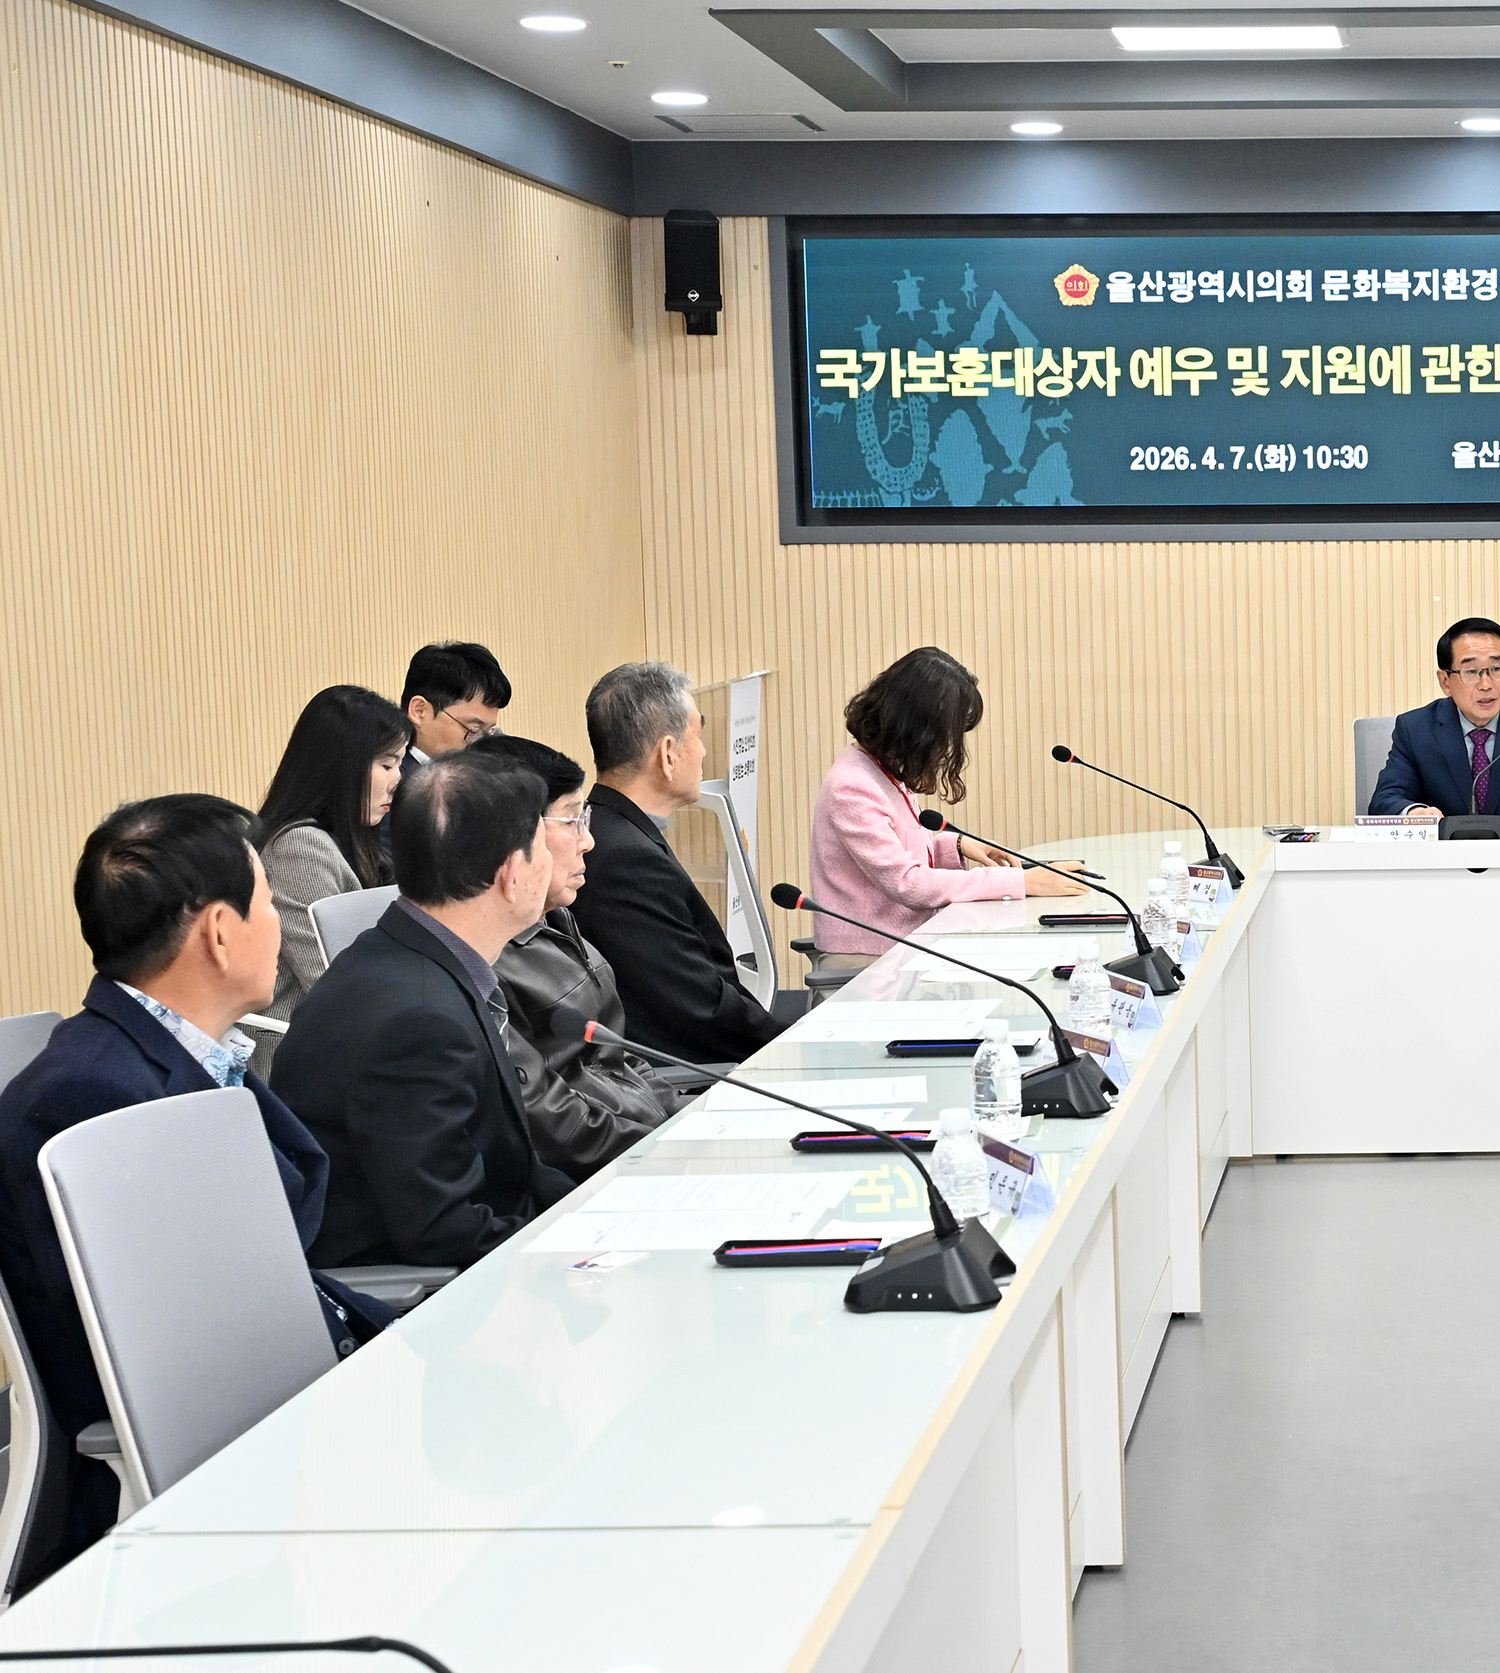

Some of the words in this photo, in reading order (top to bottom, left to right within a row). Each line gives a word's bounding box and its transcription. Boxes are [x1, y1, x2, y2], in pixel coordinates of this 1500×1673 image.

[1066, 280, 1088, 292] 의회
[1105, 269, 1313, 304] 울산광역시의회
[816, 346, 1121, 399] 국가보훈대상자
[1129, 346, 1218, 397] 예우
[1227, 345, 1270, 397] 및
[1279, 344, 1412, 396] 지원에
[1302, 444, 1369, 470] 10:30
